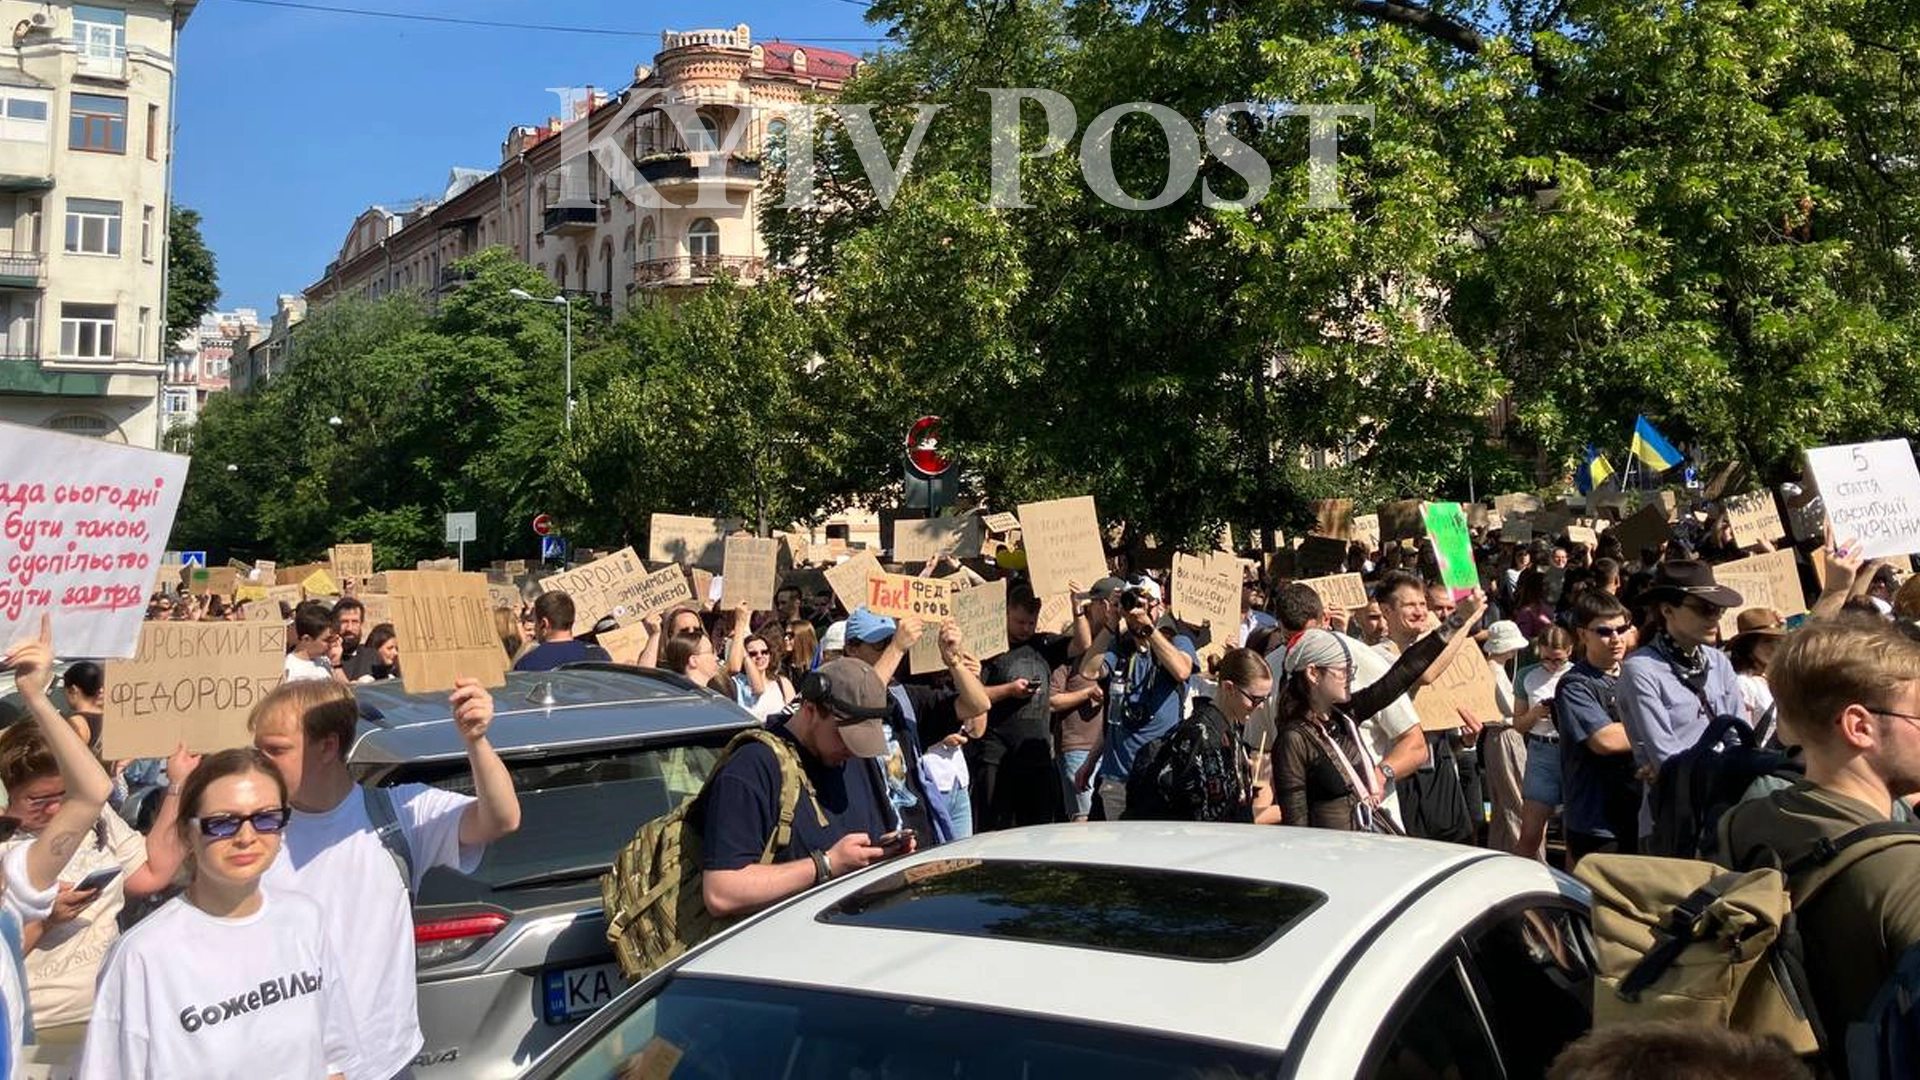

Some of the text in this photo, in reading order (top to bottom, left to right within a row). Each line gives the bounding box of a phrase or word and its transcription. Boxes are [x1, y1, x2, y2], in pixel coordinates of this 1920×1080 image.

[1852, 446, 1869, 472] 5
[54, 477, 164, 513] сьогодні
[1836, 479, 1883, 497] СТАТТЯ
[5, 510, 150, 551] бути такою,
[8, 540, 149, 586] суспільство
[60, 583, 142, 612] завтра
[617, 568, 679, 602] ЗМІНИМОСЬ
[627, 583, 687, 617] ЗАГИНЕМО
[869, 578, 910, 610] Так!
[913, 601, 950, 616] ОРОВ
[111, 676, 254, 717] ФЕДОРОВ
[410, 1047, 459, 1067] AV4
